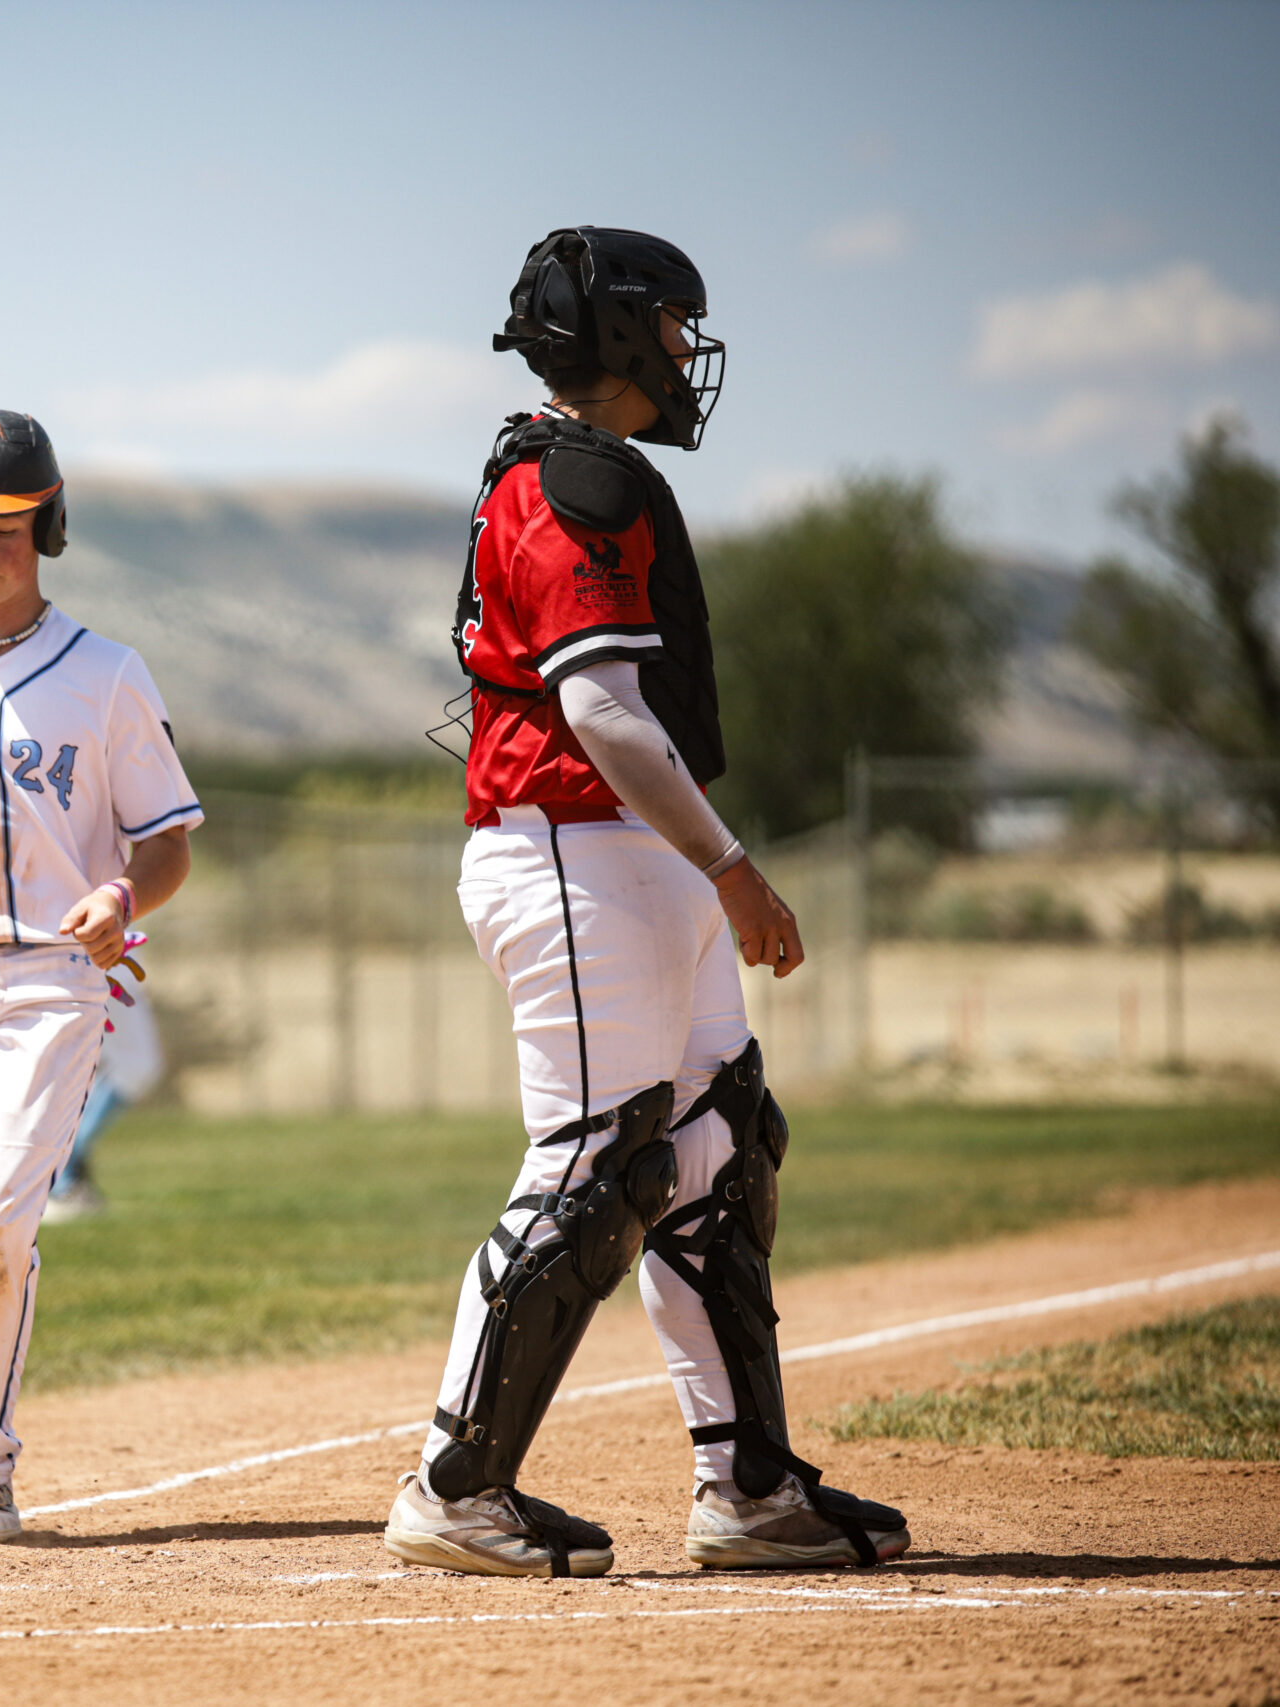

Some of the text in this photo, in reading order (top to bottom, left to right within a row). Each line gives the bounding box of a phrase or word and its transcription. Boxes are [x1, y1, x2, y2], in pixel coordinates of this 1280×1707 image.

[609, 284, 647, 292] EASTON
[575, 582, 638, 596] SECURITY
[10, 739, 79, 811] 24
